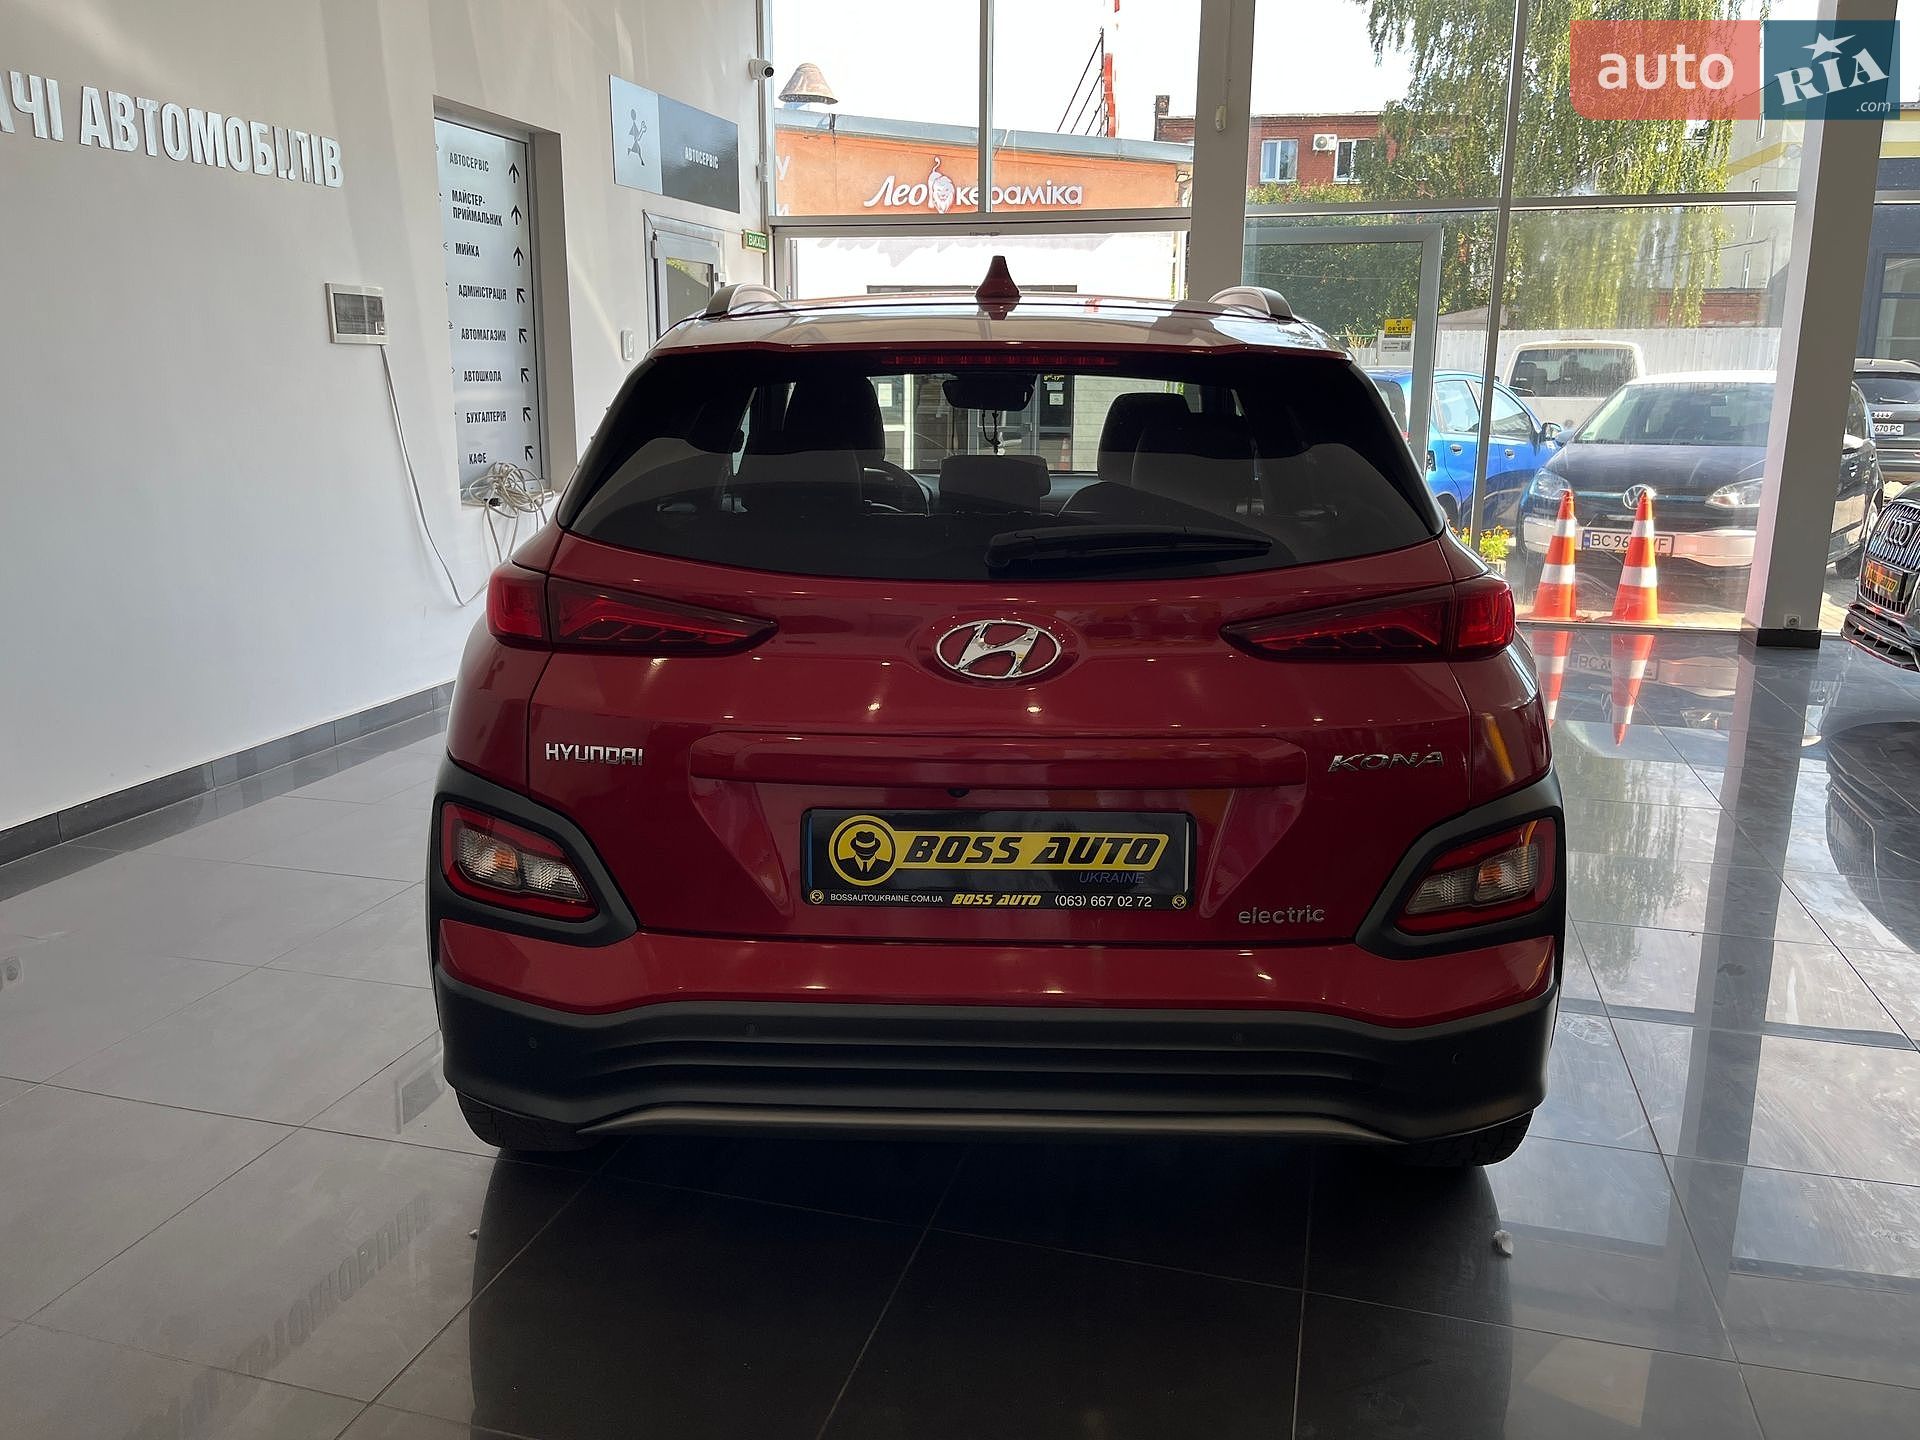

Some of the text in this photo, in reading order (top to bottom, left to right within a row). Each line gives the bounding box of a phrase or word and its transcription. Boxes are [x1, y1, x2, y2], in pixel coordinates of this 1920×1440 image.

[80, 85, 344, 188] АВТОМОБІЛІВ
[450, 152, 489, 172] АВТОСЕРВІС
[451, 189, 486, 207] МАЙСТЕР-
[864, 175, 928, 208] Лео
[452, 207, 503, 227] ПРИЙМАЛЬНИК
[748, 234, 767, 249] ВИХІД
[455, 242, 480, 258] МИЙКА
[458, 284, 507, 301] АДМІНІСТРАЦІЯ
[461, 328, 507, 342] АВТОМАГАЗИН
[463, 370, 502, 383] АВТОШКОЛА
[466, 410, 507, 424] БУХГАЛТЕРІЯ
[1873, 424, 1889, 433] 670
[468, 452, 487, 465] КАФЕ
[1591, 533, 1611, 547] BC
[545, 742, 644, 766] HYUNDAI
[1327, 751, 1444, 773] KONA
[903, 835, 1161, 865] BOSS AUTO
[1078, 872, 1146, 884] UKRAINE
[830, 893, 1152, 907] BOSSAUTOUKRAINE.COM.UA BOSS AUTO (063) 667 02 72
[1238, 905, 1325, 924] electric
